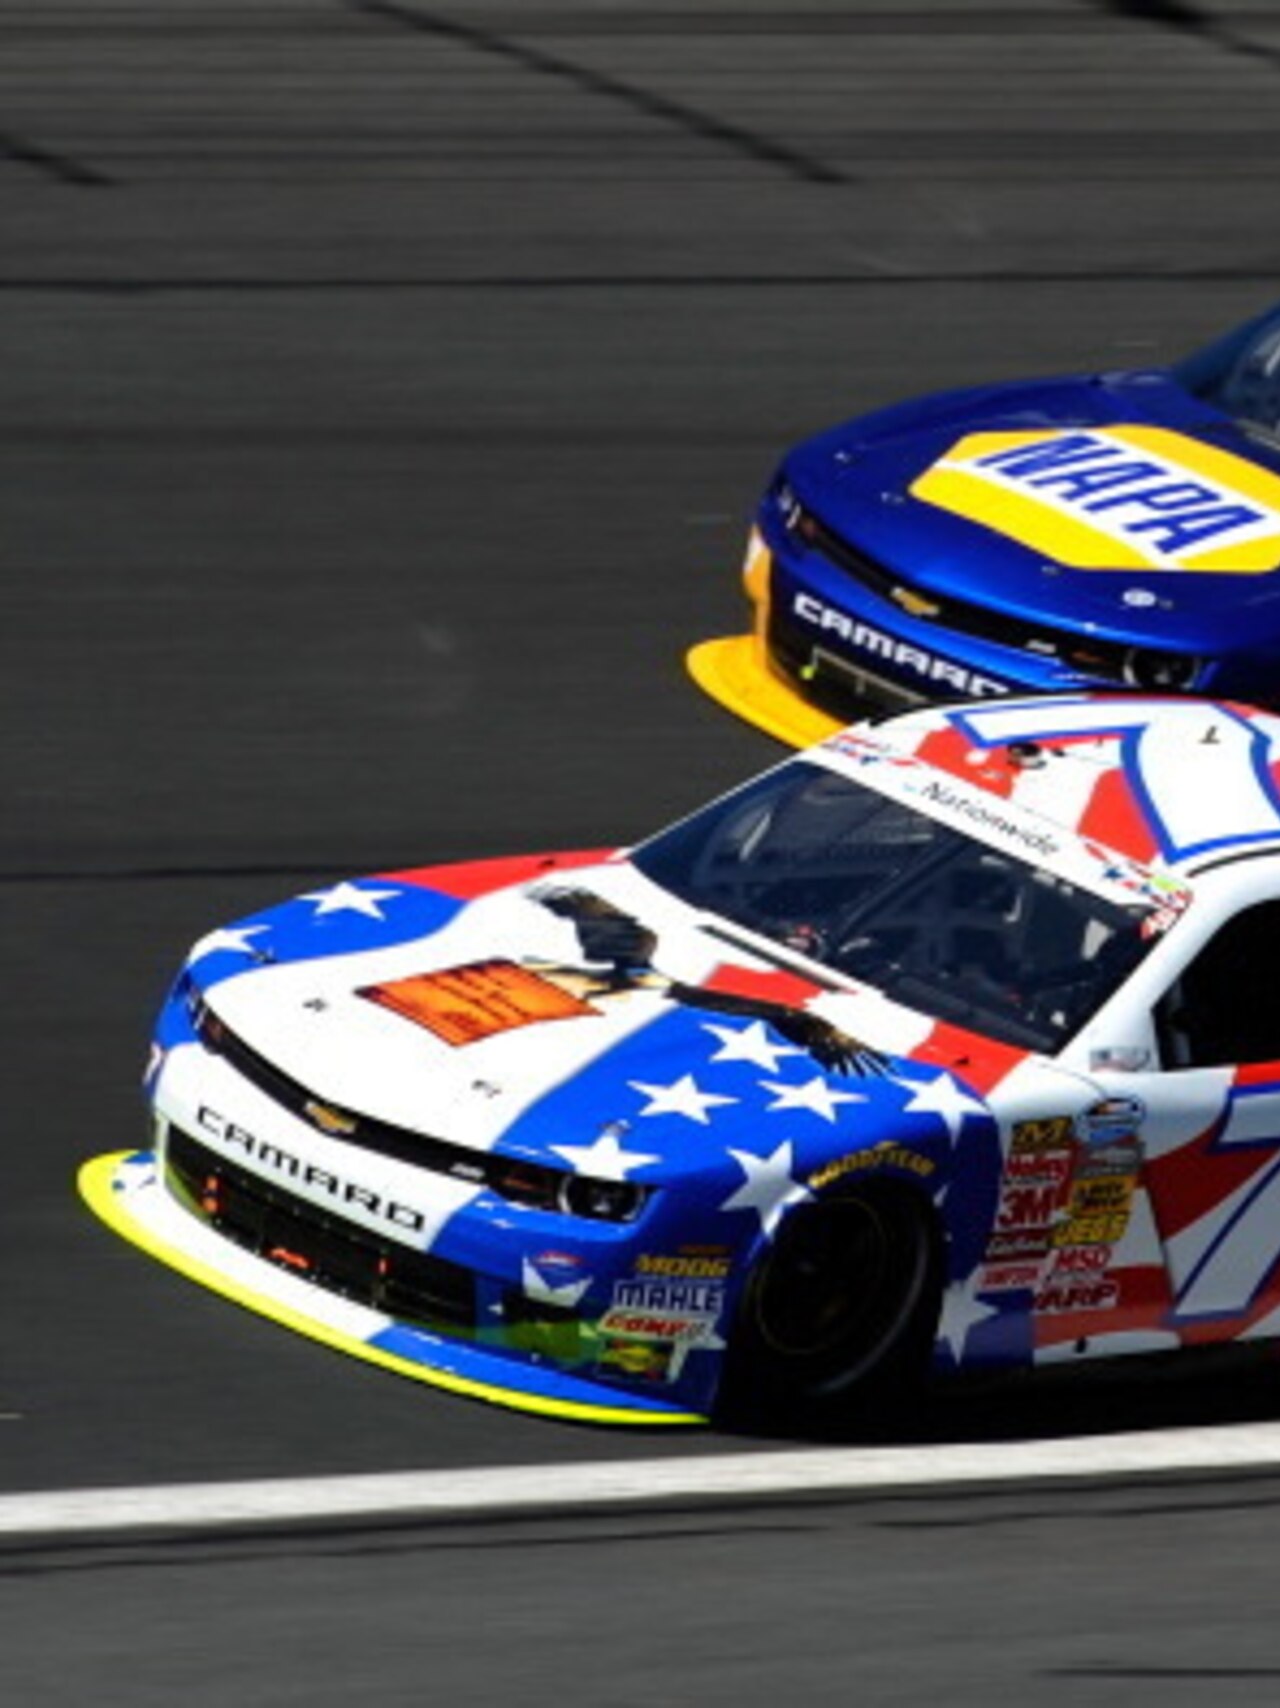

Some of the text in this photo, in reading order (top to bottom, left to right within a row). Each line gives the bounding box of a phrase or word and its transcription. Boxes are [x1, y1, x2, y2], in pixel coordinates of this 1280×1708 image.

[971, 433, 1267, 555] NAPA
[921, 780, 1062, 857] Nationwide
[198, 1105, 427, 1233] CAMARO
[618, 1284, 723, 1313] MAHLE
[636, 1256, 729, 1277] MOOG
